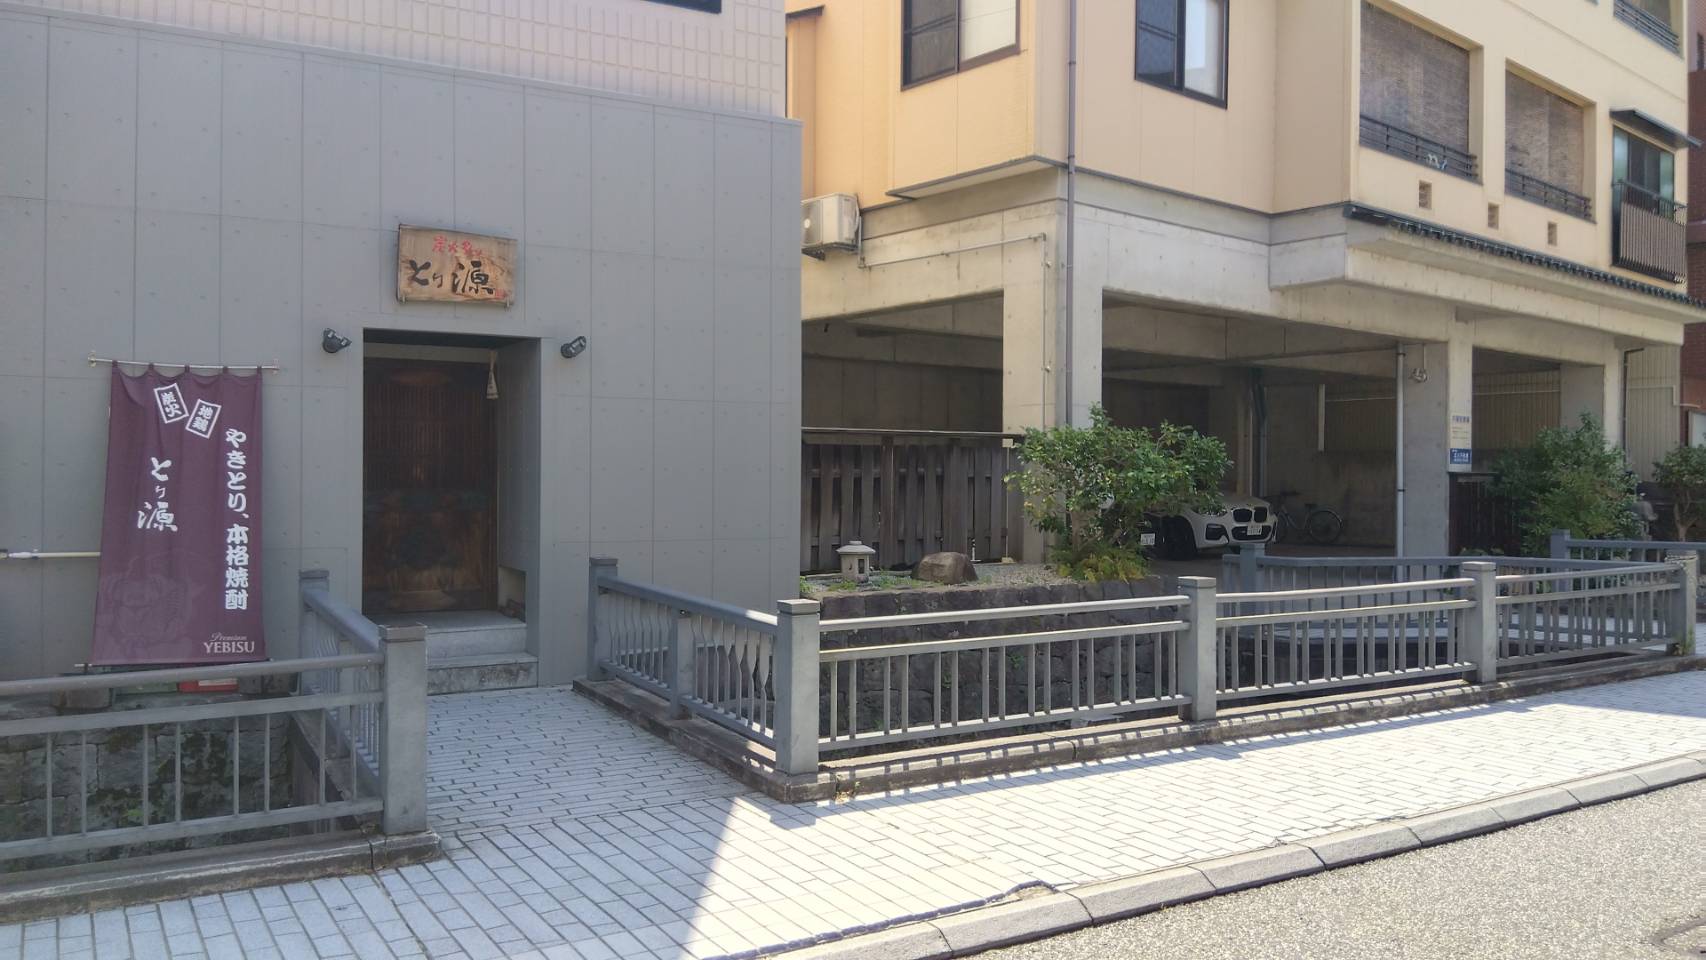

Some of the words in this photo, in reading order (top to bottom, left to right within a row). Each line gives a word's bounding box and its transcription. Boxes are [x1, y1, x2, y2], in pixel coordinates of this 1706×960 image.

[408, 260, 495, 295] とり源
[192, 405, 214, 432] 地鶏
[137, 456, 178, 532] とり源
[225, 428, 249, 610] やきとり、本格焼酎
[203, 641, 255, 654] YEBISU
[209, 632, 248, 641] Premium
